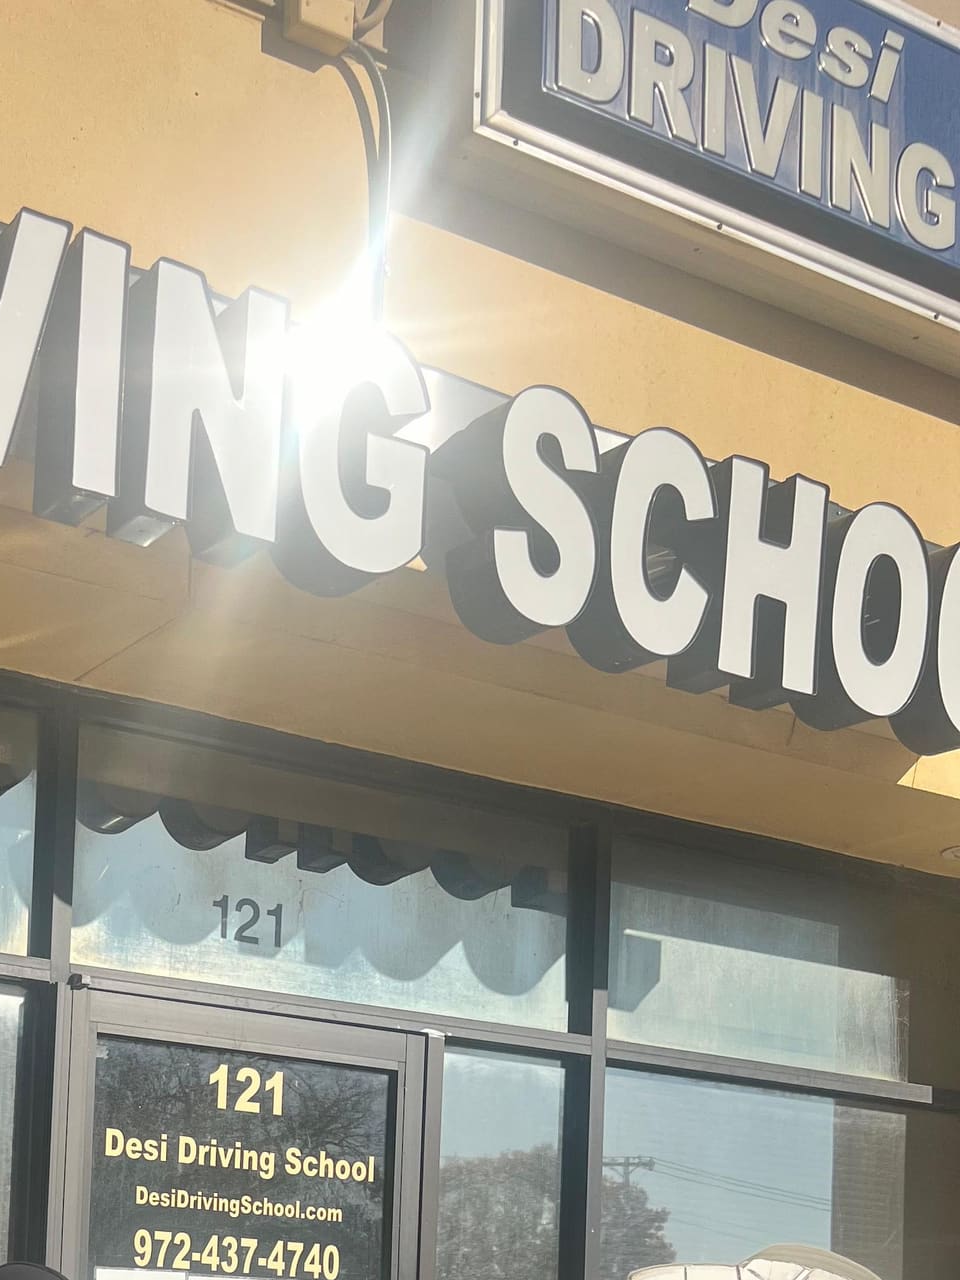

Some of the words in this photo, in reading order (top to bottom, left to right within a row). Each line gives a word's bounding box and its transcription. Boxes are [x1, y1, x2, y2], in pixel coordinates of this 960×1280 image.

[554, 0, 957, 250] DRIVING
[493, 385, 960, 735] SCHO
[213, 894, 283, 948] 121
[209, 1063, 284, 1116] 121
[104, 1127, 168, 1162] Desi
[178, 1135, 275, 1180] Driving
[284, 1147, 375, 1183] School
[135, 1185, 343, 1222] DesiDrivingSchool.com
[133, 1229, 340, 1280] 972-437-4740
